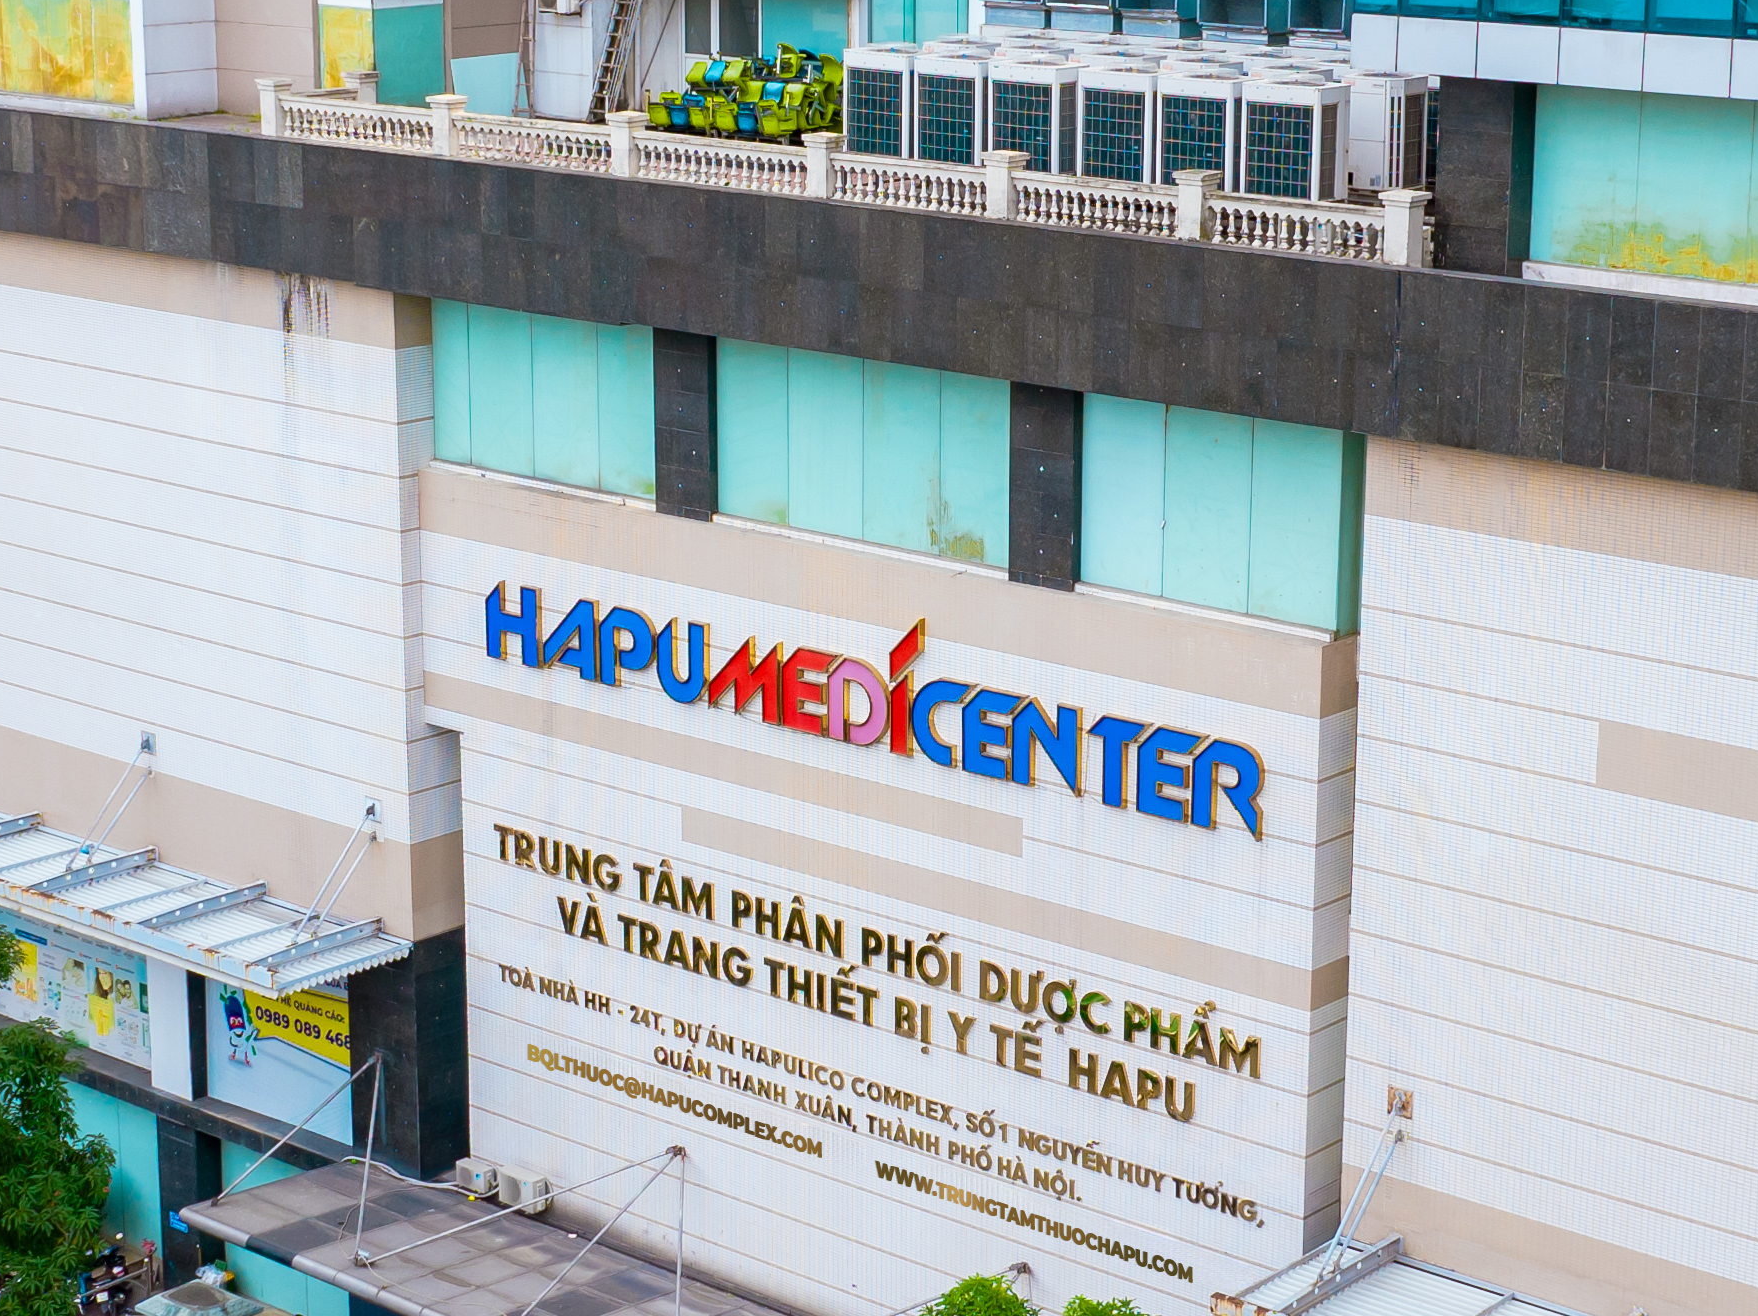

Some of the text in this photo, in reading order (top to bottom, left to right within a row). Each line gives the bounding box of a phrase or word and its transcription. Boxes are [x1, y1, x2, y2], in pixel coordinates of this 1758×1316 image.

[255, 1005, 290, 1029] 0989
[294, 1018, 321, 1040] 089
[494, 822, 1262, 1080] TRUNG TÂM PHÂN PHỐI DƯỢC PHẨM
[556, 892, 609, 946] VÀ
[617, 912, 755, 986] TRANG
[763, 956, 881, 1026] THIẾT
[894, 994, 932, 1055] BỊ
[947, 1009, 978, 1055] Y
[1068, 1046, 1197, 1123] HAPU
[498, 963, 536, 992] TOÀ
[539, 975, 580, 1006] NHÀ
[584, 990, 612, 1016] HH
[629, 1004, 667, 1036] 24T,
[673, 1018, 702, 1049] DỰ
[706, 1024, 735, 1055] ÁN
[741, 1039, 845, 1091] HAPULICO
[851, 1076, 959, 1131] COMPLEX,
[1018, 1127, 1113, 1178] NGUYỄN
[1118, 1160, 1167, 1195] HUY
[1171, 1177, 1265, 1228] TƯỞNG,
[527, 1043, 823, 1159] BQLTHUOC@HAPUCOMPLEX.COM
[654, 1046, 1082, 1202] QUẬN THANH XUÂN, THÀNH PHỐ HÀ NỘI.
[874, 1160, 1194, 1284] WWW.TRUNGTAMTHUOCHAPU.COM
